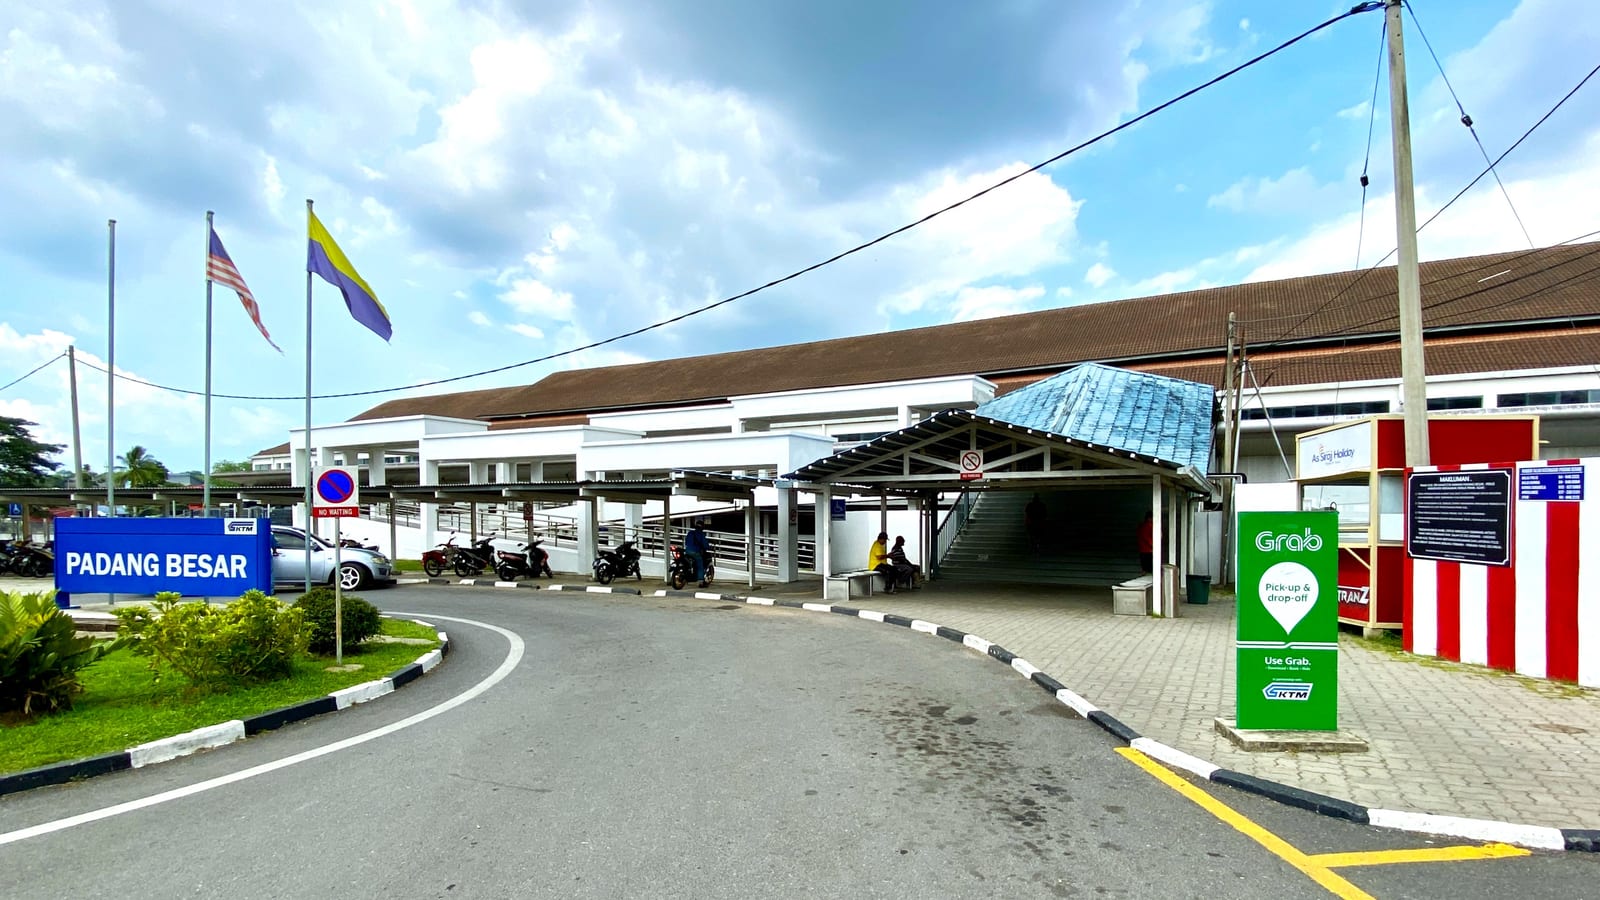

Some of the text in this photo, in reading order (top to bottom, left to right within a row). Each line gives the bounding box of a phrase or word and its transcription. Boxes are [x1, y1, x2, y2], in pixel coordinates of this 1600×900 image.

[1312, 454, 1319, 462] As
[1334, 448, 1355, 459] Holiday
[1255, 527, 1323, 552] Grab
[66, 552, 248, 578] PADANG BESAR
[1265, 583, 1311, 593] Pick-up &
[1267, 594, 1308, 604] drop-off
[1264, 656, 1312, 666] Use Grab.
